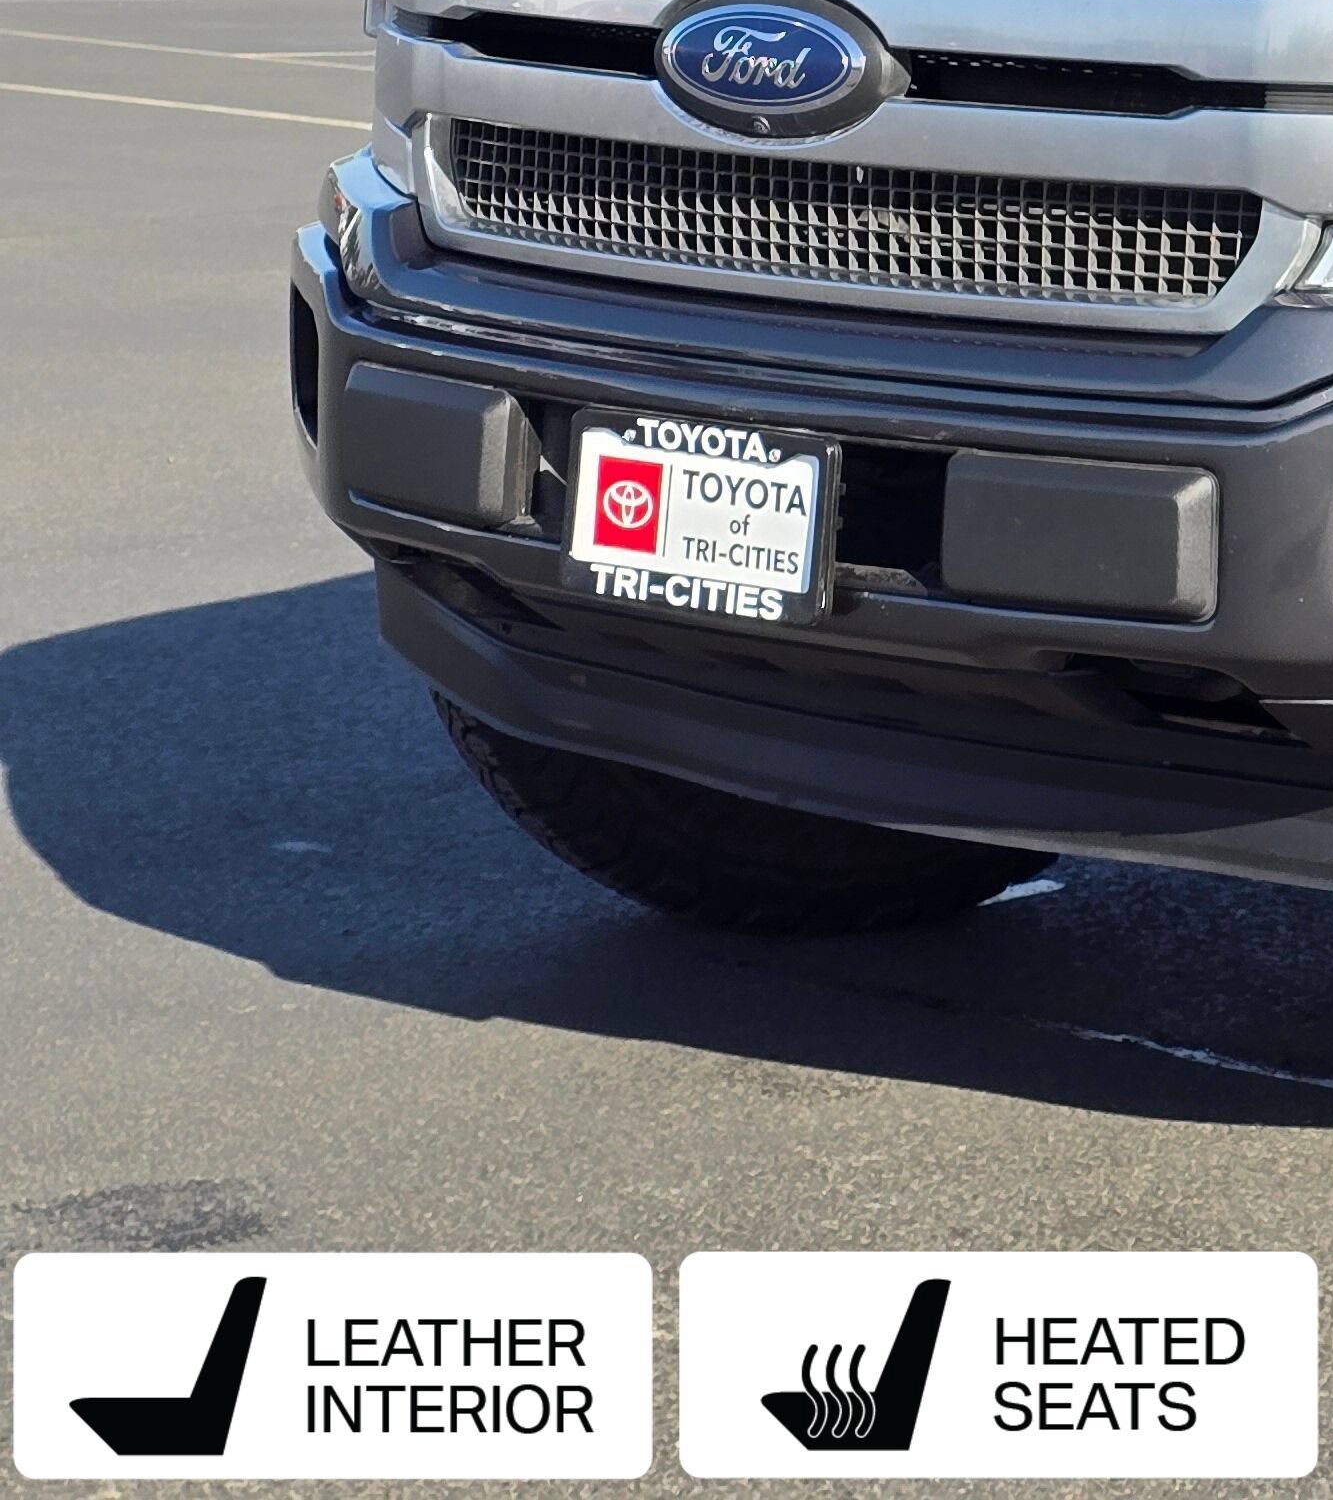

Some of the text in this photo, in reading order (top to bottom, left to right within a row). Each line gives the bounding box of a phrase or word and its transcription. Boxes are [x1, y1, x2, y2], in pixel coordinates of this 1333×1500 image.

[702, 26, 811, 89] Ford
[637, 418, 767, 463] TOYOTA
[682, 469, 807, 517] TOYOTA
[729, 514, 752, 535] of
[682, 536, 800, 576] TRI-CITIES
[590, 564, 784, 621] TRI-CITIES
